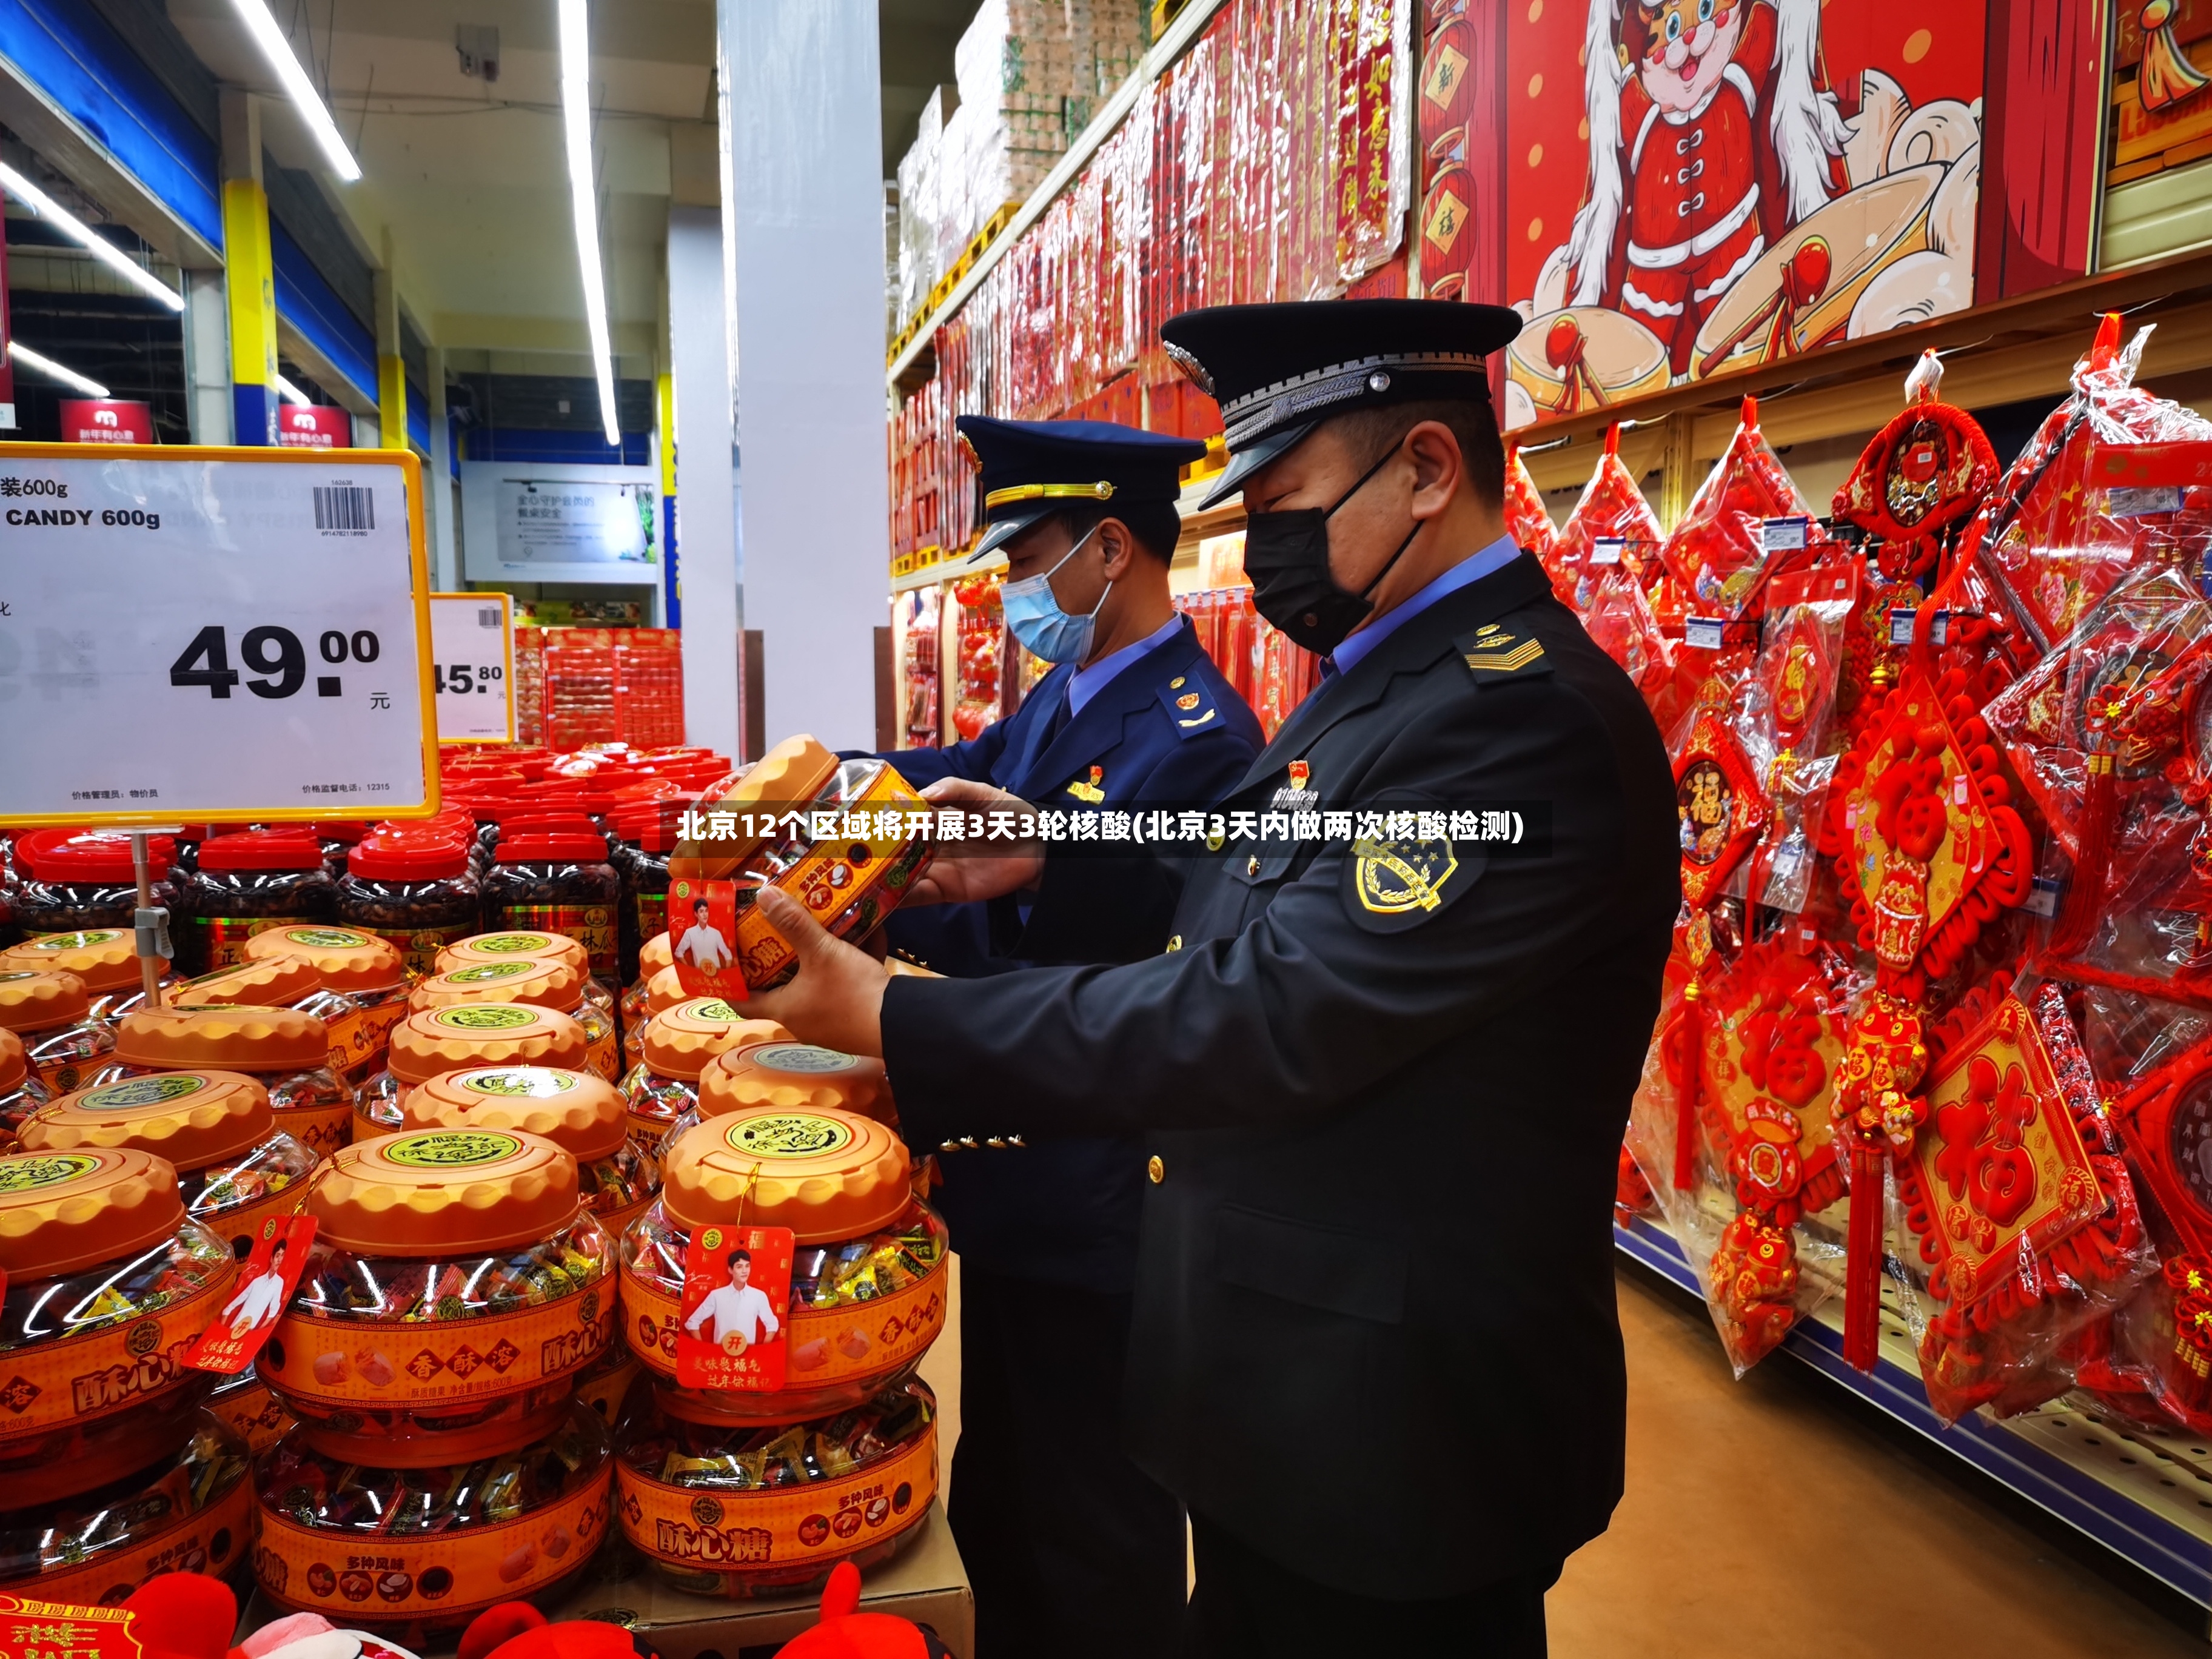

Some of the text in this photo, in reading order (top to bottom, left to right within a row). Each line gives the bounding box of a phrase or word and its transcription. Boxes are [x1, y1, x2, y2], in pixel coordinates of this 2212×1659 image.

[0, 477, 68, 498] 装600g
[6, 509, 160, 530] CANDY 600g
[170, 625, 390, 710] 49.00 元
[728, 1336, 742, 1350] 开
[837, 1483, 885, 1510] 多种风味
[657, 1519, 773, 1564] 酥心糖
[346, 1555, 406, 1572] 多种风味
